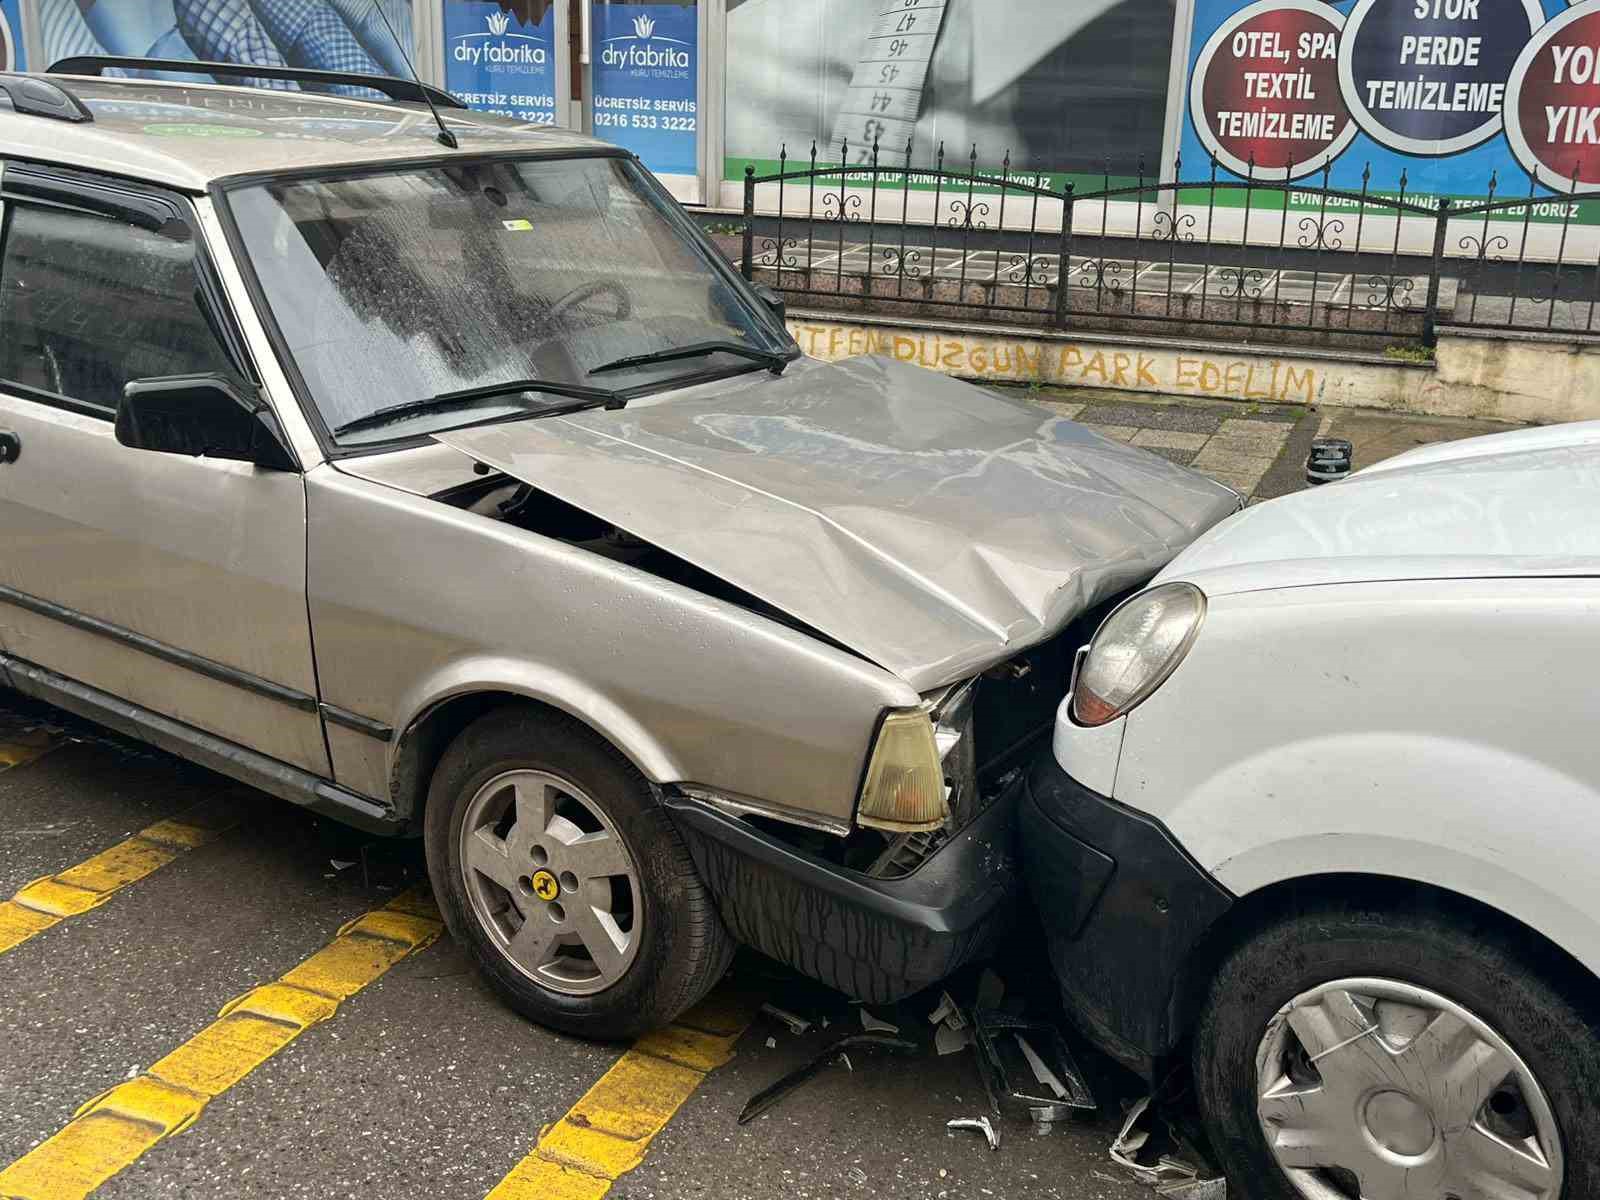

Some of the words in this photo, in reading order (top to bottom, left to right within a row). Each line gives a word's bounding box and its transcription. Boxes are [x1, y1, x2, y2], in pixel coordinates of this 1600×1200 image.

[895, 13, 917, 33] 47
[888, 39, 909, 57] 46
[1232, 31, 1290, 64] OTEL,
[1298, 32, 1337, 60] SPA
[1400, 35, 1482, 67] PERDE
[1244, 67, 1316, 100] TEXTİL
[1366, 74, 1505, 112] TEMİZLEME
[510, 94, 554, 107] SERVİS
[594, 95, 651, 111] ÜCRETSİZ
[654, 98, 697, 113] SERVİS
[871, 91, 893, 113] 44
[594, 113, 628, 127] 0216
[631, 115, 657, 129] 533
[661, 116, 697, 131] 3222
[1217, 106, 1336, 141] TEMİZLEME
[1545, 105, 1600, 145] YIK
[1056, 343, 1159, 387] PARK
